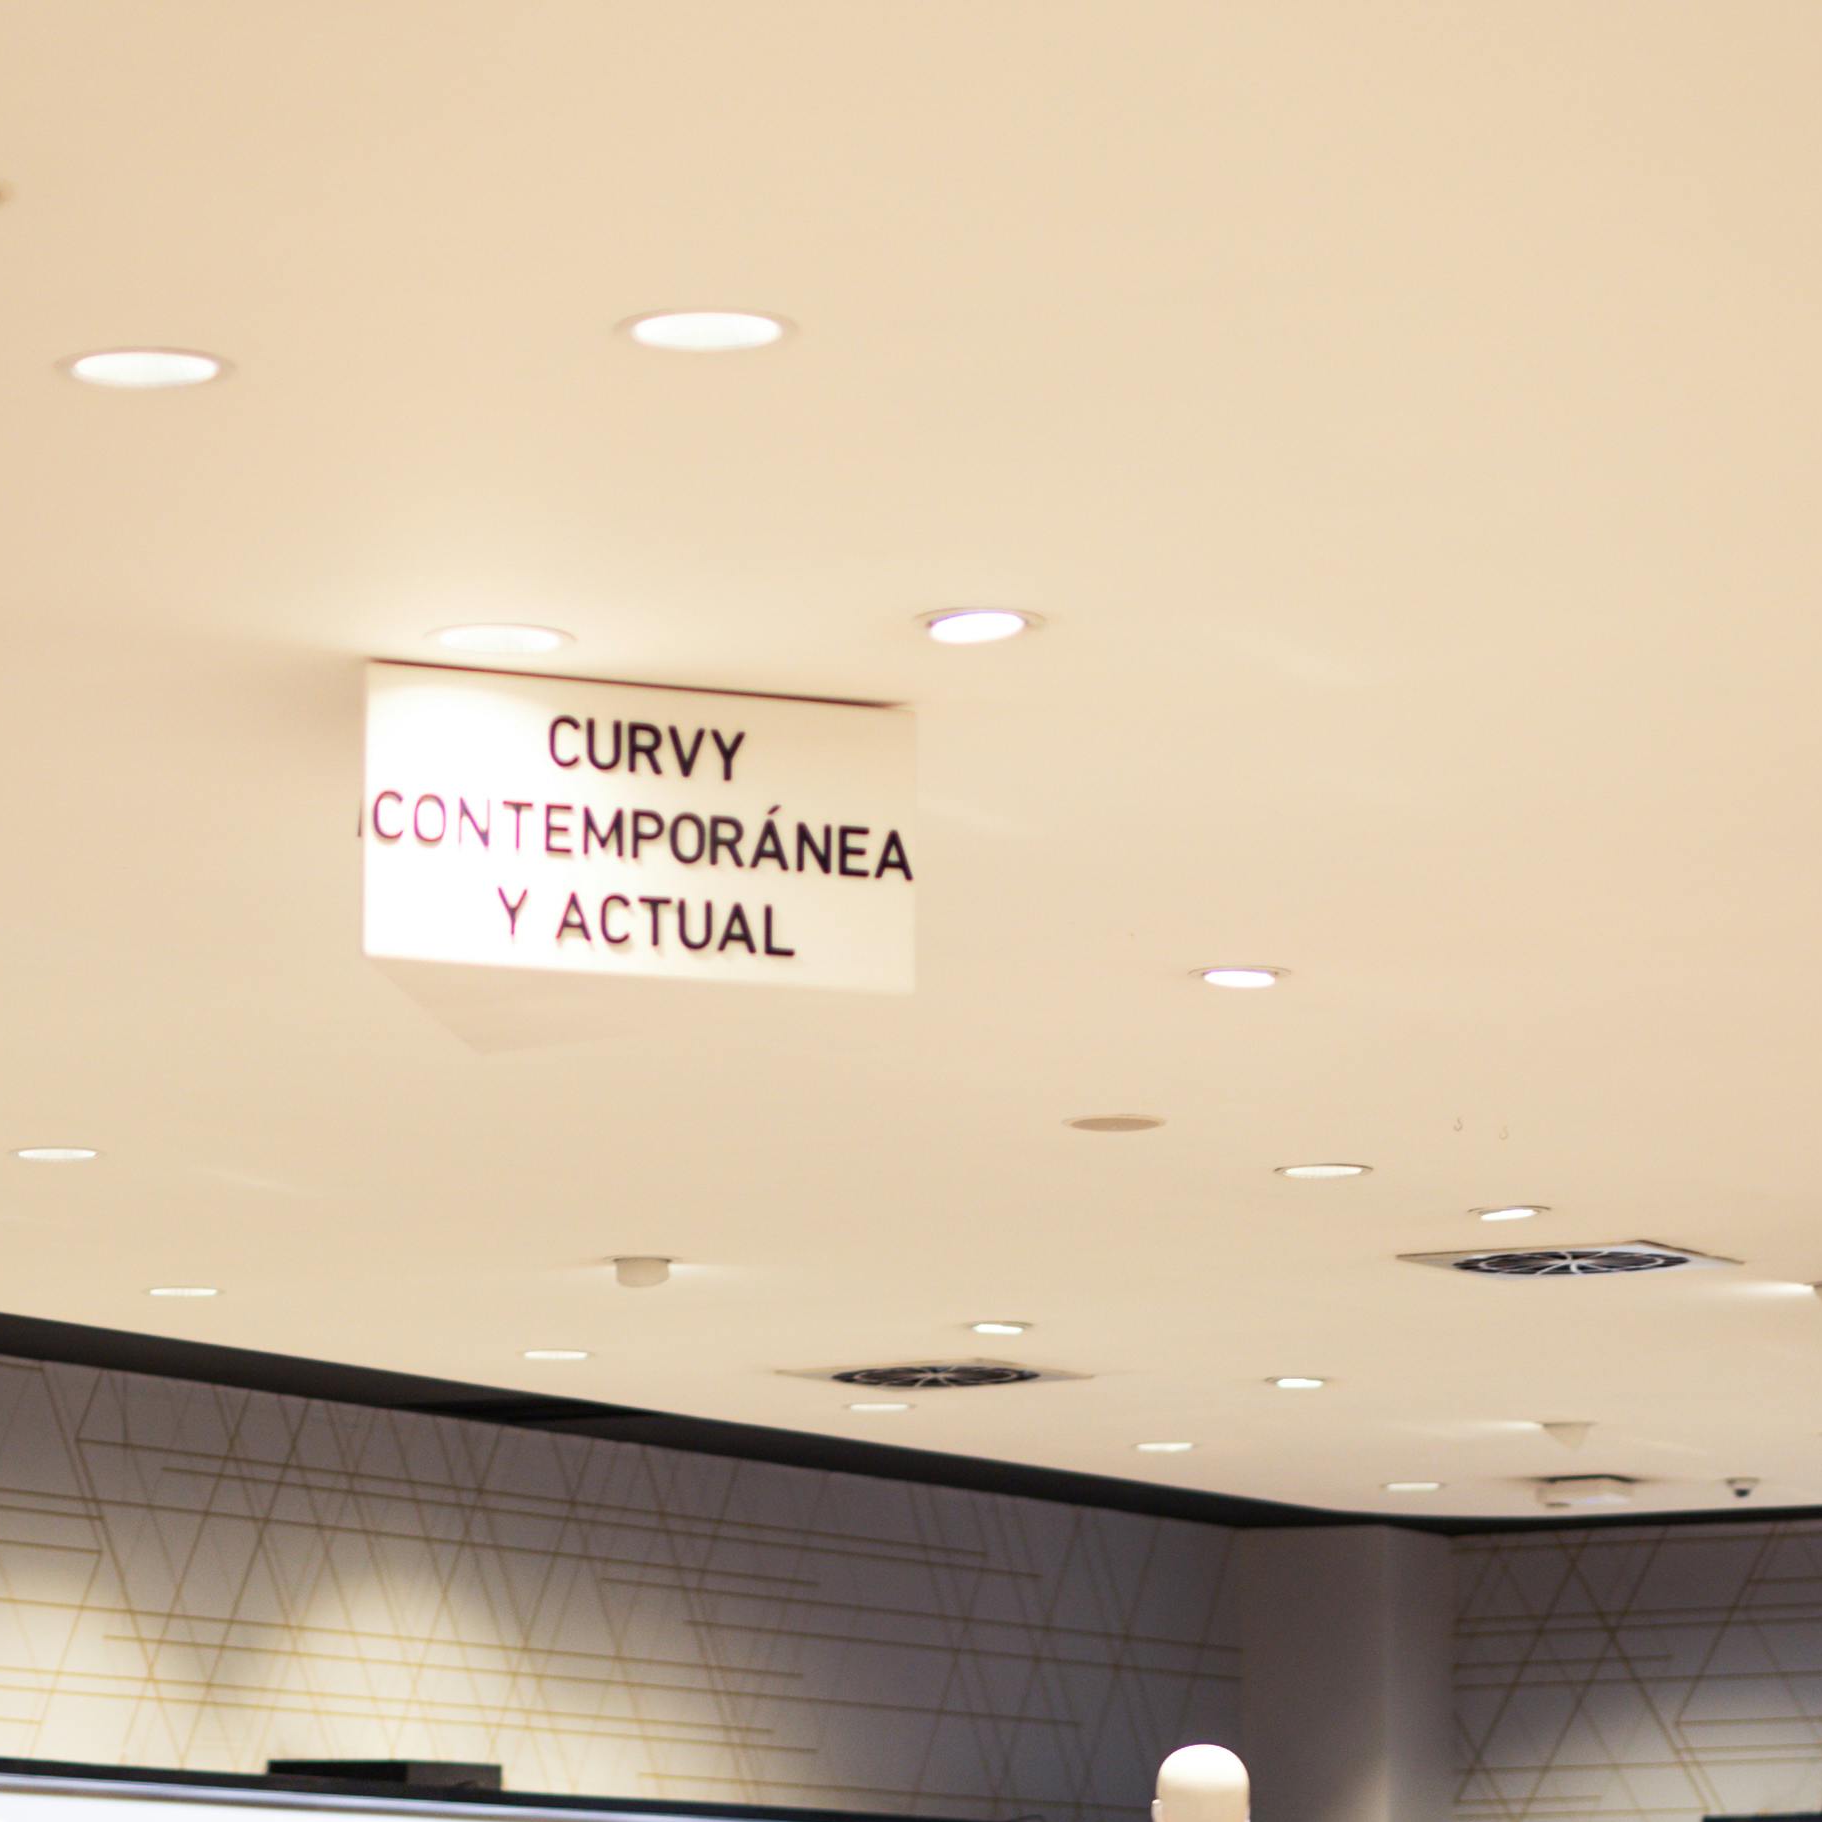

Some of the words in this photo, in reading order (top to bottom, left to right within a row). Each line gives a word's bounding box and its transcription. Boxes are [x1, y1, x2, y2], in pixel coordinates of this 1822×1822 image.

[547, 714, 746, 782] CURVY
[372, 789, 913, 882] CONTEMPORÁNEA
[497, 886, 528, 936] Y
[555, 890, 796, 957] ACTUAL
